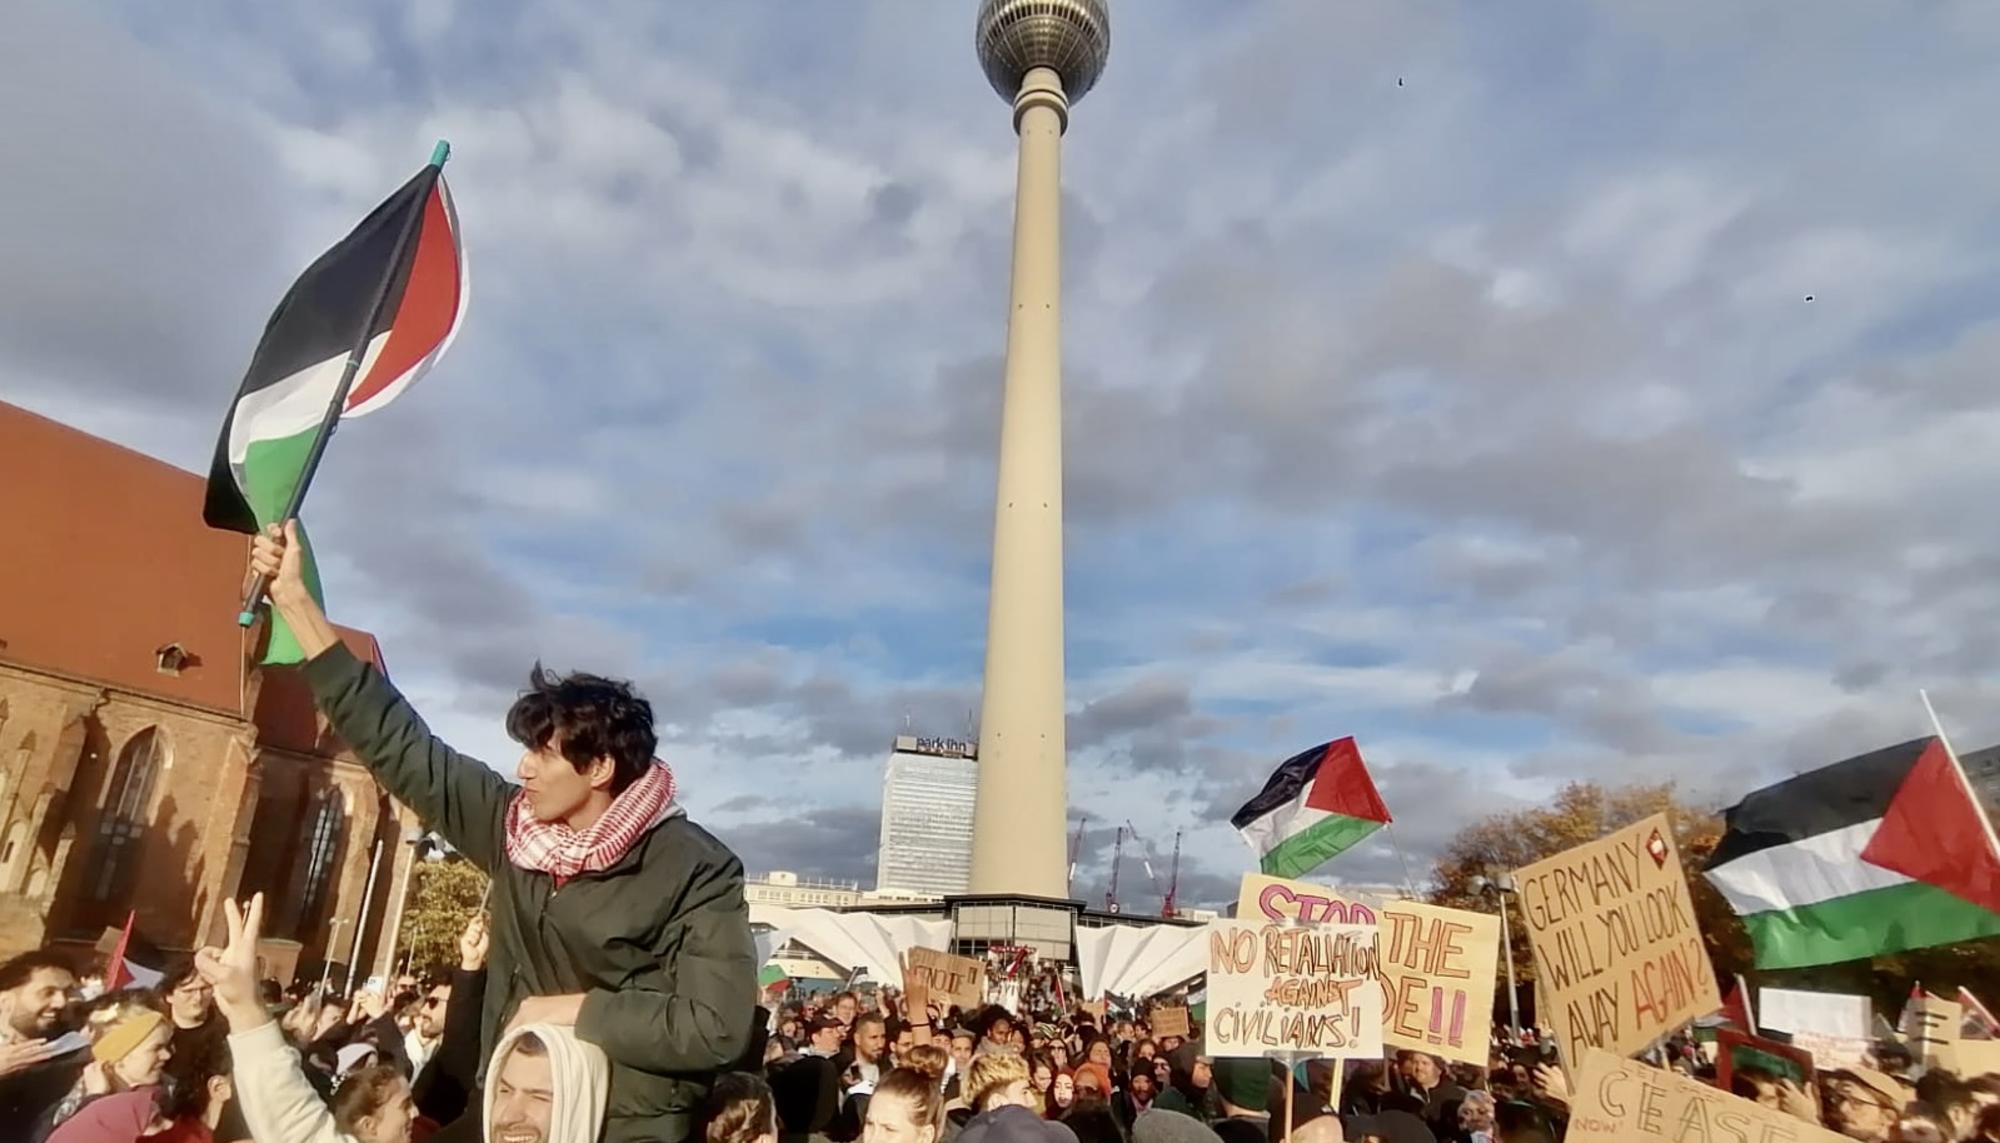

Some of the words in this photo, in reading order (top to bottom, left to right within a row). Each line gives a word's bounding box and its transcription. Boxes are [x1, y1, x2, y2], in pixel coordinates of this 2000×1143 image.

[1523, 832, 1641, 931] GERMANY
[1210, 927, 1257, 974] NO
[1260, 924, 1381, 981] RETALIATION
[1384, 911, 1473, 979] THE
[1538, 921, 1603, 991] WILL
[1596, 902, 1640, 968] YOU
[1640, 880, 1690, 944] LOOK
[1264, 974, 1363, 1016] AGAINST
[1566, 981, 1619, 1068] AWAY
[1630, 937, 1709, 1031] AGAIN?
